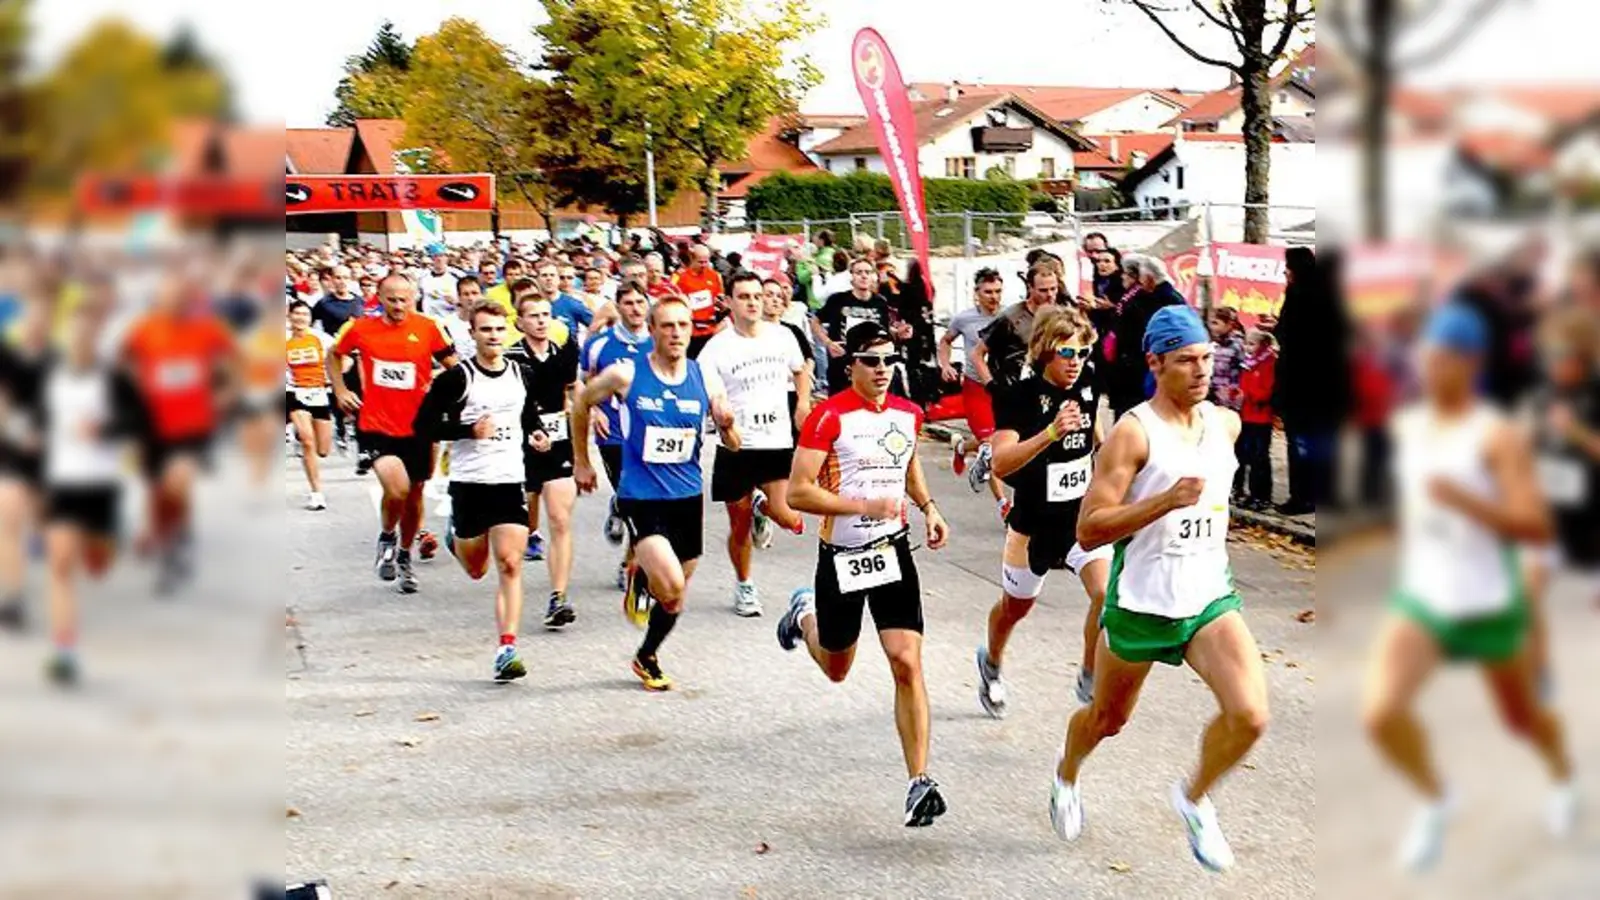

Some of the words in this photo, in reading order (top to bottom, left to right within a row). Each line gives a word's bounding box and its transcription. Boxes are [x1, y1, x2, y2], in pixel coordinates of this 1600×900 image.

[753, 411, 777, 424] 116
[655, 438, 684, 453] 291
[1063, 433, 1086, 450] GER
[1059, 469, 1087, 489] 454
[1179, 518, 1212, 539] 311
[848, 554, 886, 577] 396
